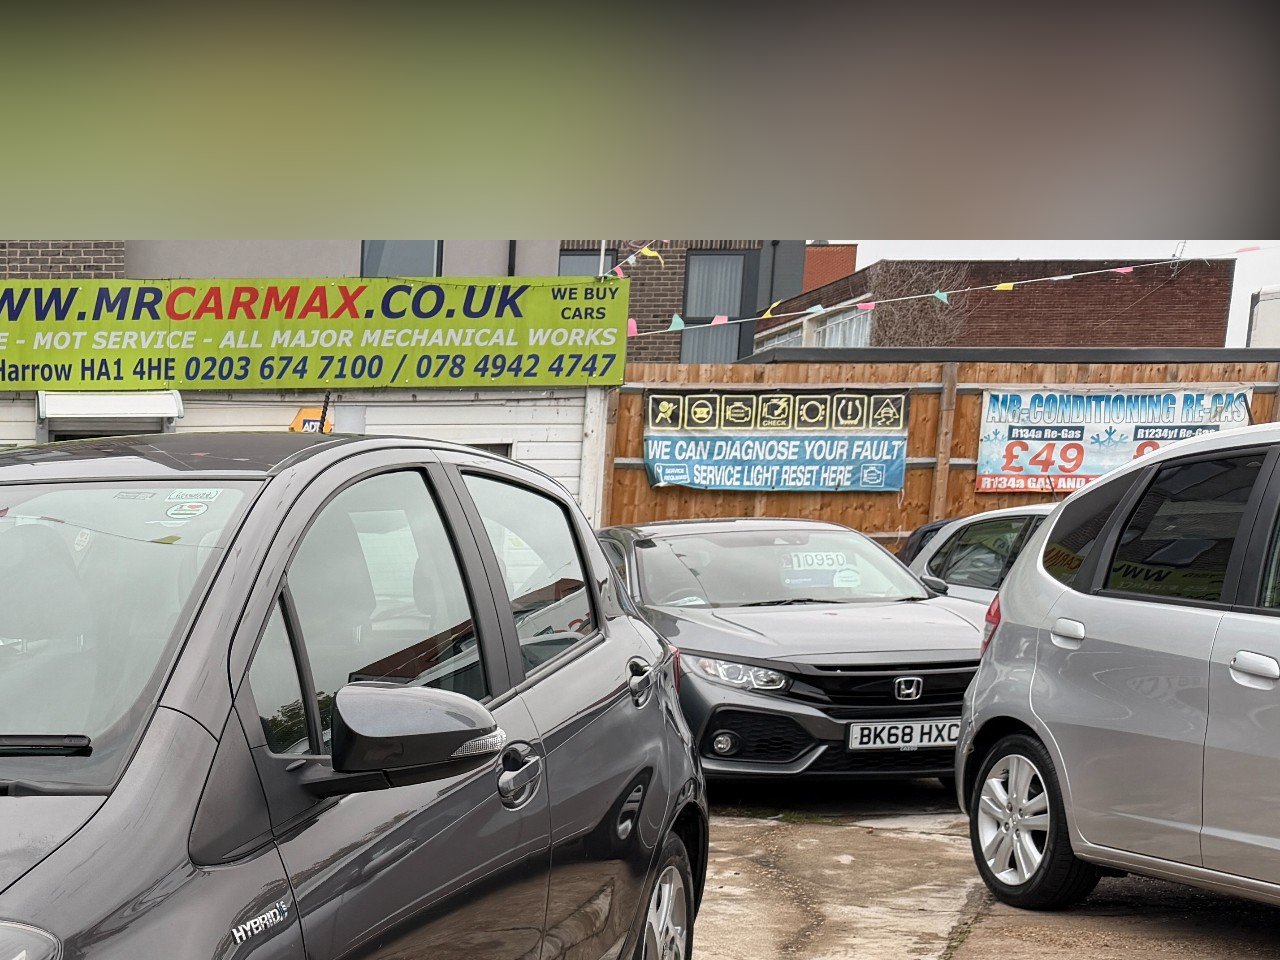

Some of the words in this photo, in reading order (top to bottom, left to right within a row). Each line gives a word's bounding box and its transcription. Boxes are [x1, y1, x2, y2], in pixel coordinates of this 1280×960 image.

[552, 288, 578, 301] WE
[583, 287, 619, 301] BUY
[560, 307, 606, 320] CARS
[33, 332, 86, 349] MOT
[92, 330, 195, 349] SERVICE
[219, 330, 261, 348] ALL
[270, 330, 354, 349] MAJOR
[360, 328, 518, 347] MECHANICAL
[528, 328, 618, 346] WORKS
[80, 358, 124, 381] HA1
[132, 358, 176, 380] 4HE
[184, 357, 251, 381] 0203
[258, 356, 308, 380] 674
[317, 355, 383, 379] 7100
[390, 354, 408, 383] /
[416, 355, 465, 378] 078
[474, 354, 539, 378] 4942
[548, 354, 617, 377] 4747
[986, 393, 1176, 424] AIR-CONDITIONING
[1180, 393, 1247, 423] RE-GAS
[1011, 429, 1042, 439] R134a
[1044, 429, 1081, 439] Re-Gas
[648, 440, 672, 460] WE
[674, 440, 711, 460] CAN
[712, 440, 800, 461] DIAGNOSE
[803, 440, 849, 460] YOUR
[851, 440, 903, 460] FAULT
[1000, 441, 1085, 474] £49
[693, 464, 742, 486] SERVICE
[743, 465, 780, 486] LIGHT
[780, 465, 820, 486] RESET
[820, 465, 852, 486] HERE
[981, 477, 1025, 489] R134a
[1027, 477, 1055, 489] GAS
[859, 726, 914, 745] BK68
[920, 723, 959, 743] HXC
[231, 908, 280, 943] HYBRID
